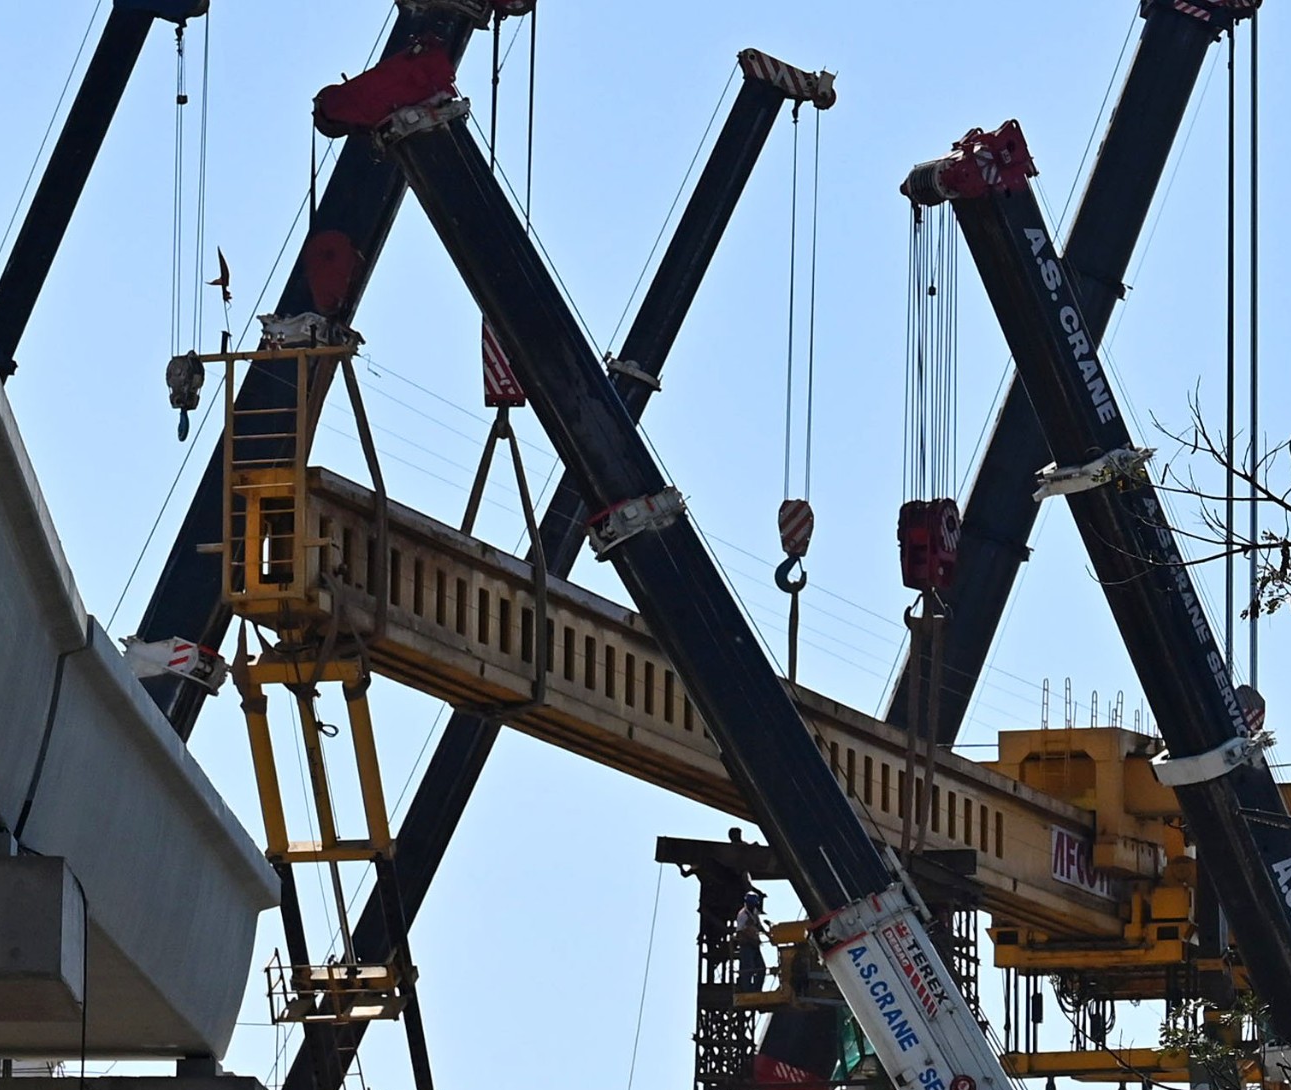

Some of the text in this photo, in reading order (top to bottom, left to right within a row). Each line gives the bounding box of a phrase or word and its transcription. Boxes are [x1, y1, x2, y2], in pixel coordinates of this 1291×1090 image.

[1059, 305, 1116, 425] CRANE
[883, 930, 909, 968] DEMAG
[907, 938, 949, 1006] TEREX
[847, 945, 919, 1052] A.S.CRANE
